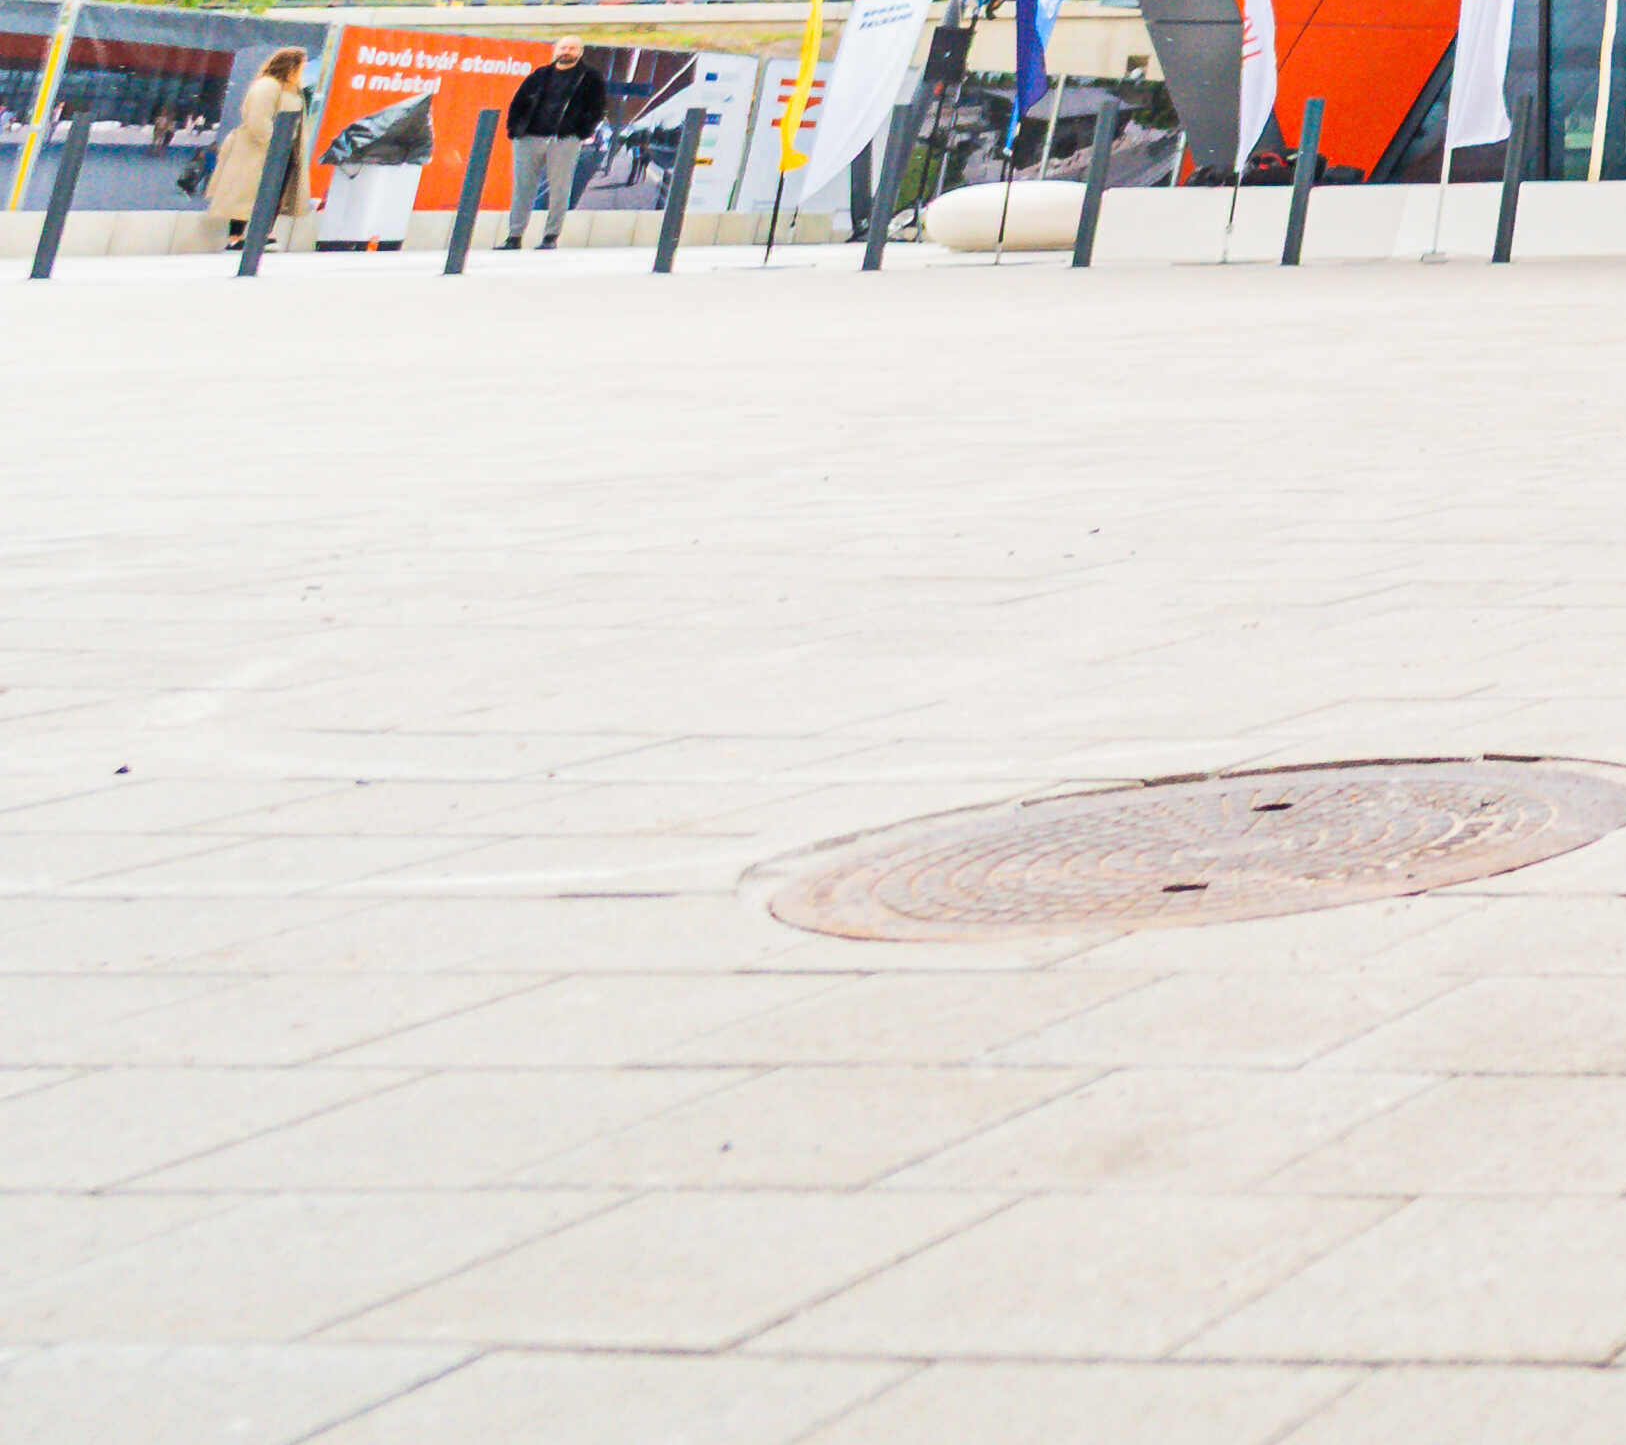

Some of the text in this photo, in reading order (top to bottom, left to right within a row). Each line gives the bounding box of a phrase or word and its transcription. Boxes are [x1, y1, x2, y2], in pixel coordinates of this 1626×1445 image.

[357, 45, 413, 68] Nová
[460, 55, 532, 77] stanice
[351, 73, 366, 90] a
